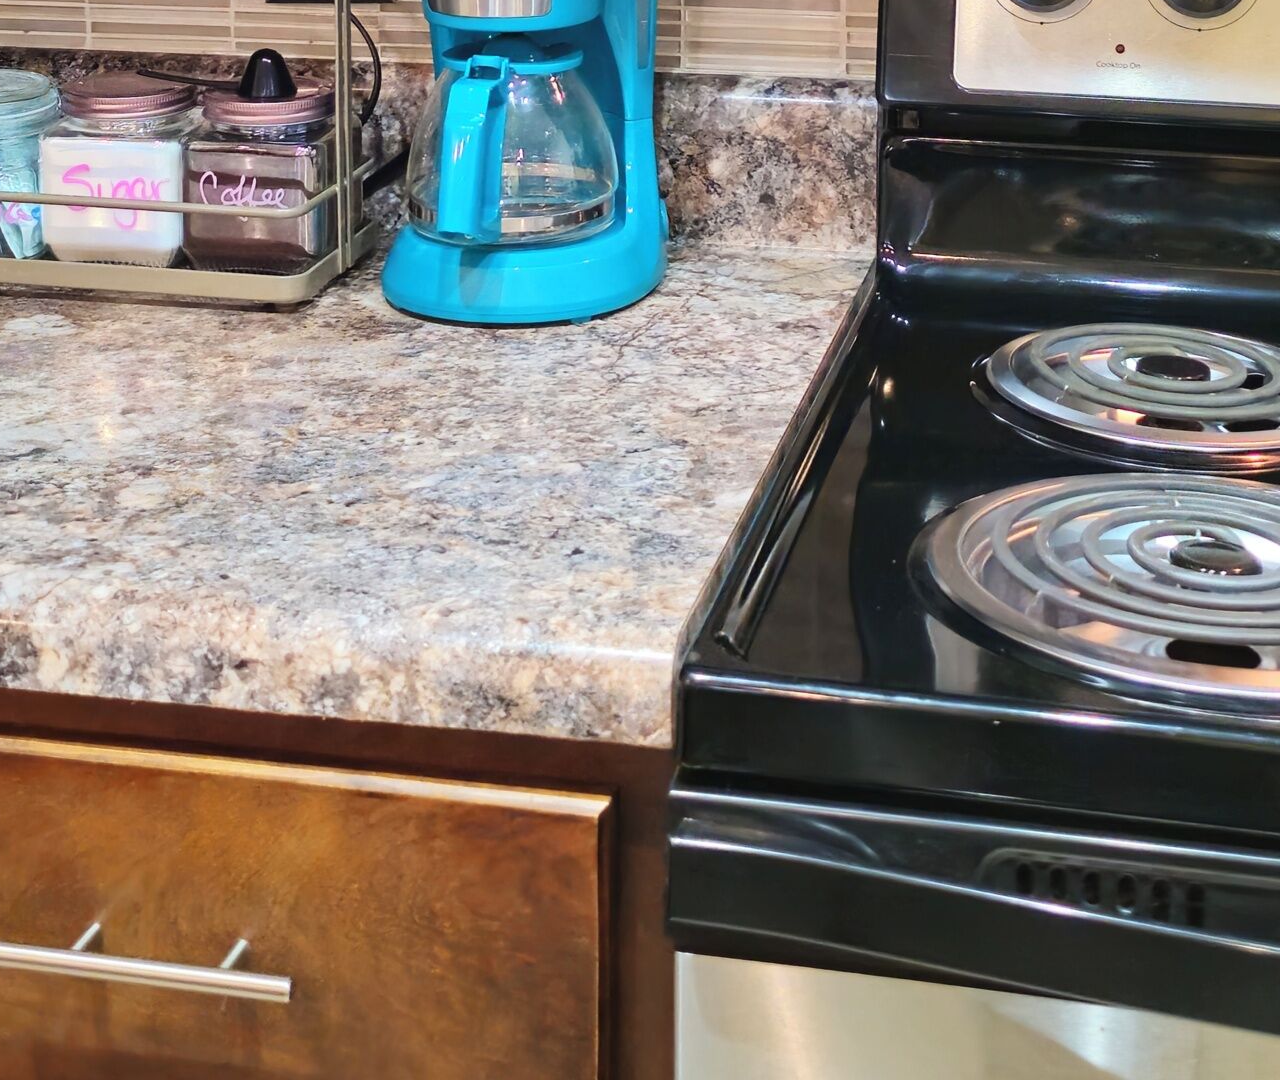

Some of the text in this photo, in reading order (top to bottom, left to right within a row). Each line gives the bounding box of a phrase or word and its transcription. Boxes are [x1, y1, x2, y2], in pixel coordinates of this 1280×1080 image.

[1095, 61, 1141, 70] Cooktop On
[199, 171, 288, 222] Coffee
